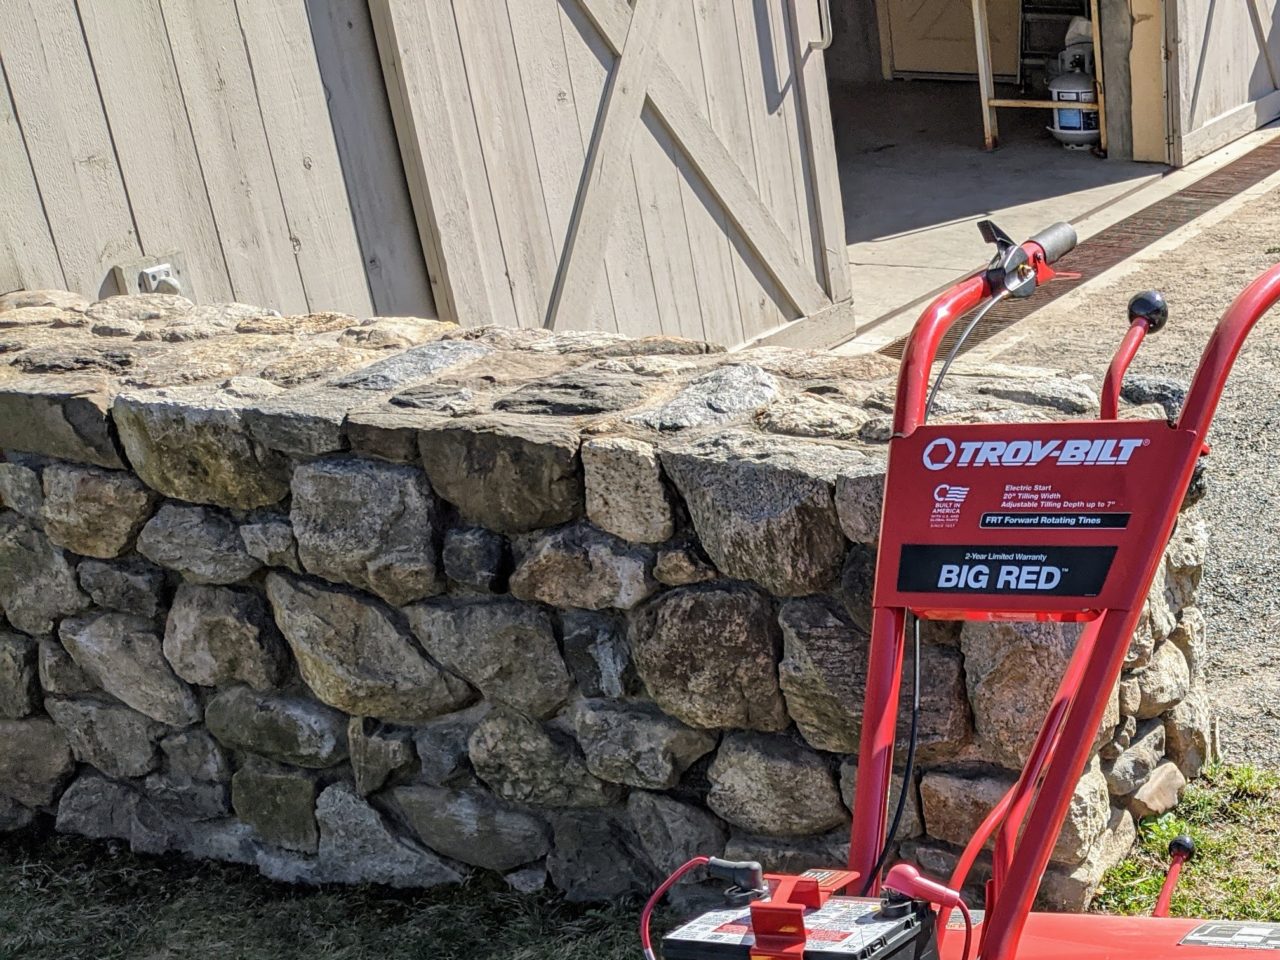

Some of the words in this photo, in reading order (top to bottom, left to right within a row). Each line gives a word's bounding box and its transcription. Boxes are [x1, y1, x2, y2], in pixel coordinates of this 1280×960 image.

[956, 439, 1143, 467] TROY-BILT
[1018, 492, 1038, 500] Tilling
[1040, 492, 1061, 500] Width
[986, 516, 1003, 524] FRT
[1004, 516, 1038, 524] Forward
[1040, 516, 1076, 526] Rotating
[1078, 516, 1101, 524] Tines
[965, 552, 986, 560] 2-Year
[988, 552, 1014, 561] Limited
[1016, 553, 1047, 562] Warranty
[937, 564, 990, 589] BIG
[997, 565, 1062, 590] RED
